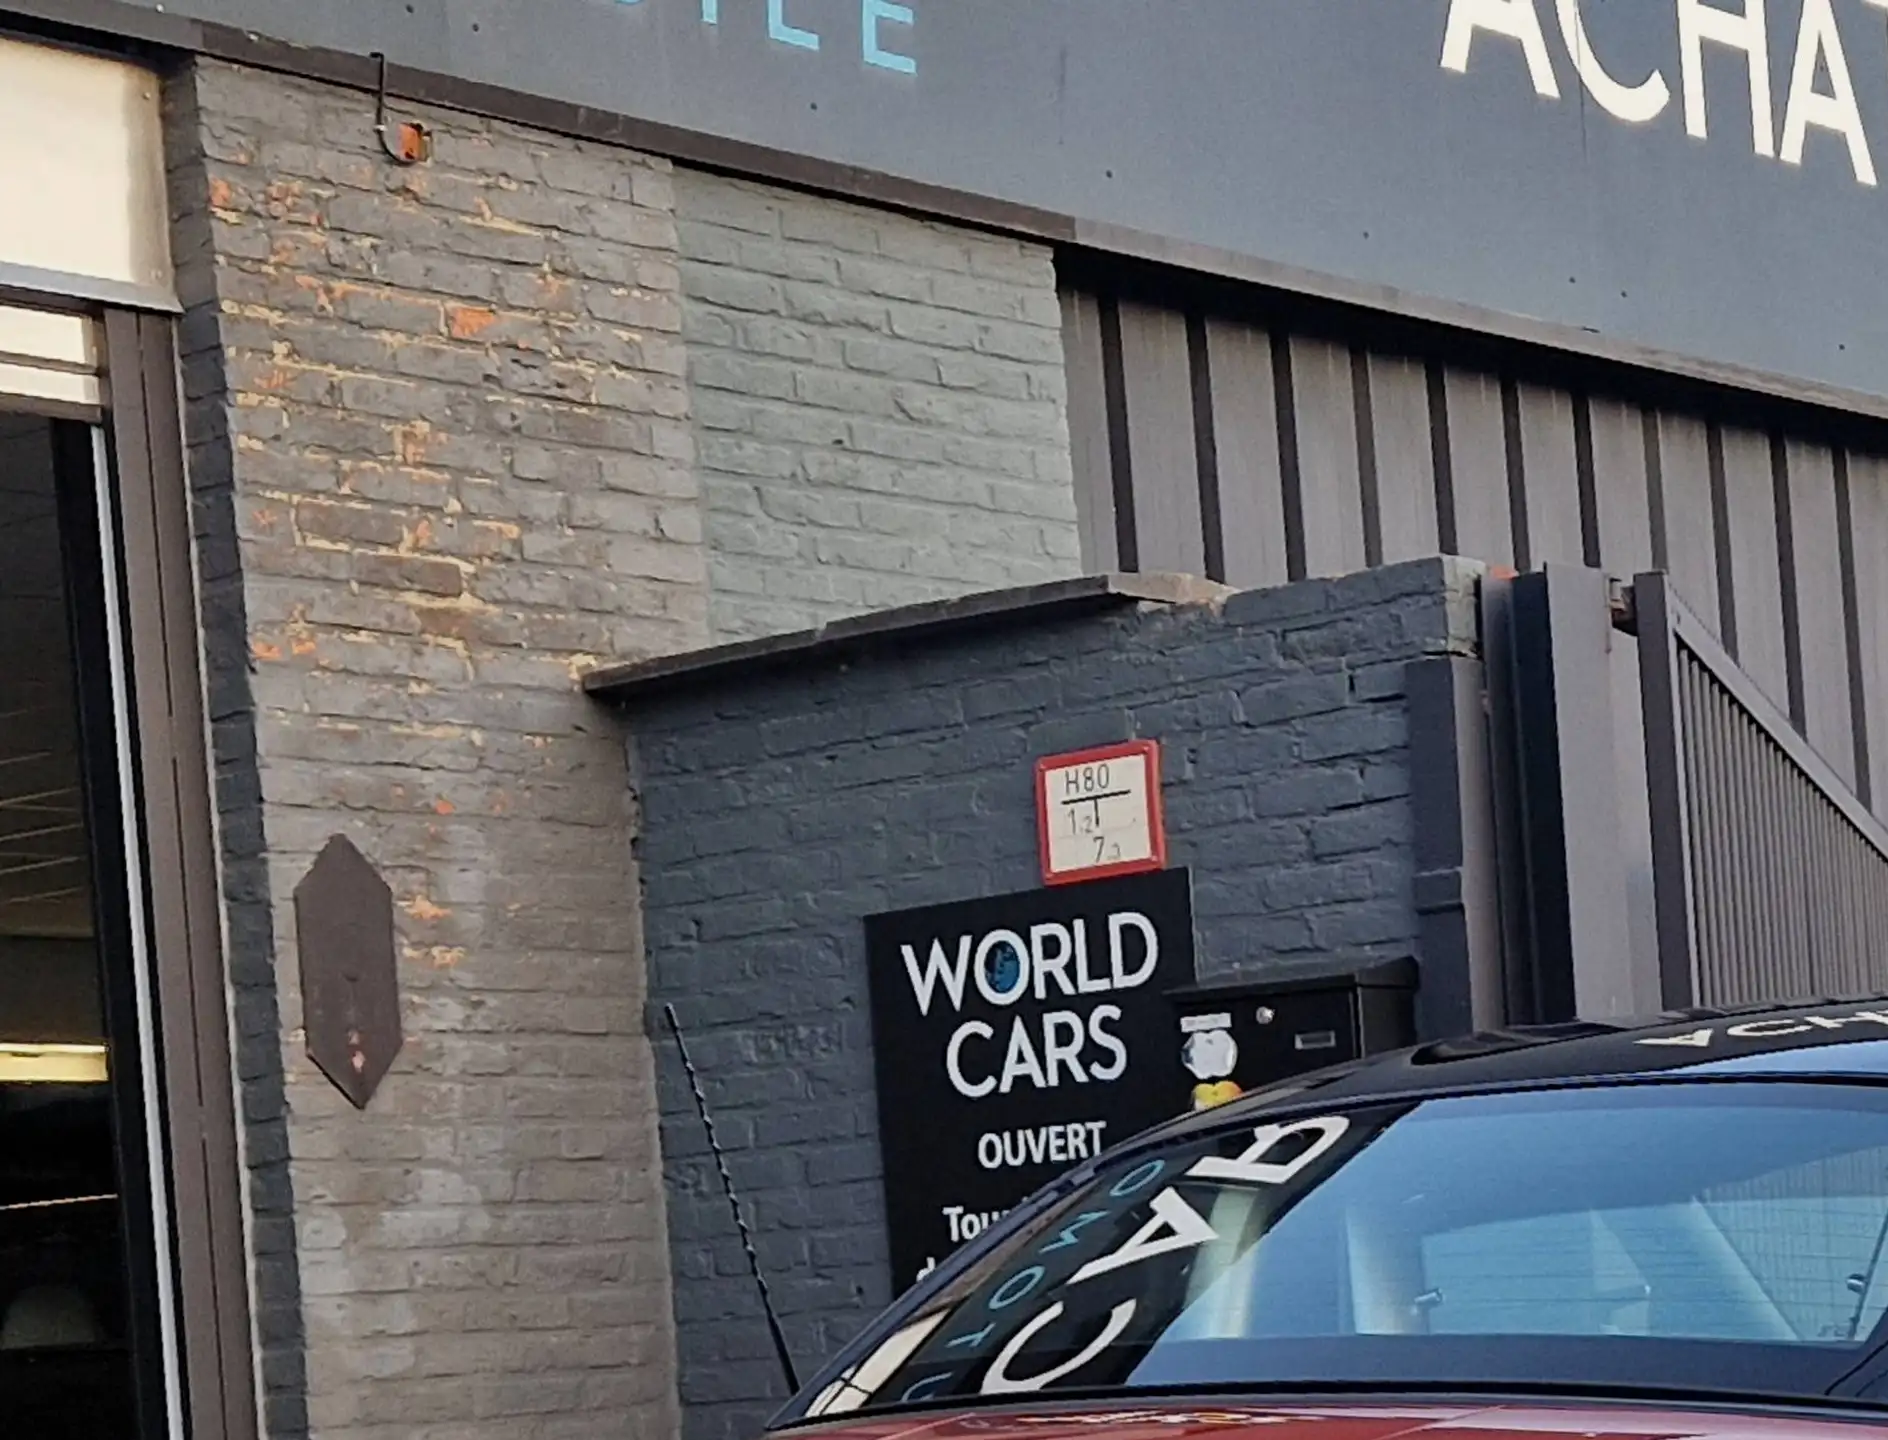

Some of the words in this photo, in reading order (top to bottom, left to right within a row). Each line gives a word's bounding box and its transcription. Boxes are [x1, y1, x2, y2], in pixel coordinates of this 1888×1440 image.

[1065, 763, 1110, 795] H80
[901, 912, 1159, 1016] WORLD
[946, 1004, 1128, 1098] CARS
[978, 1121, 1107, 1169] OUVERT
